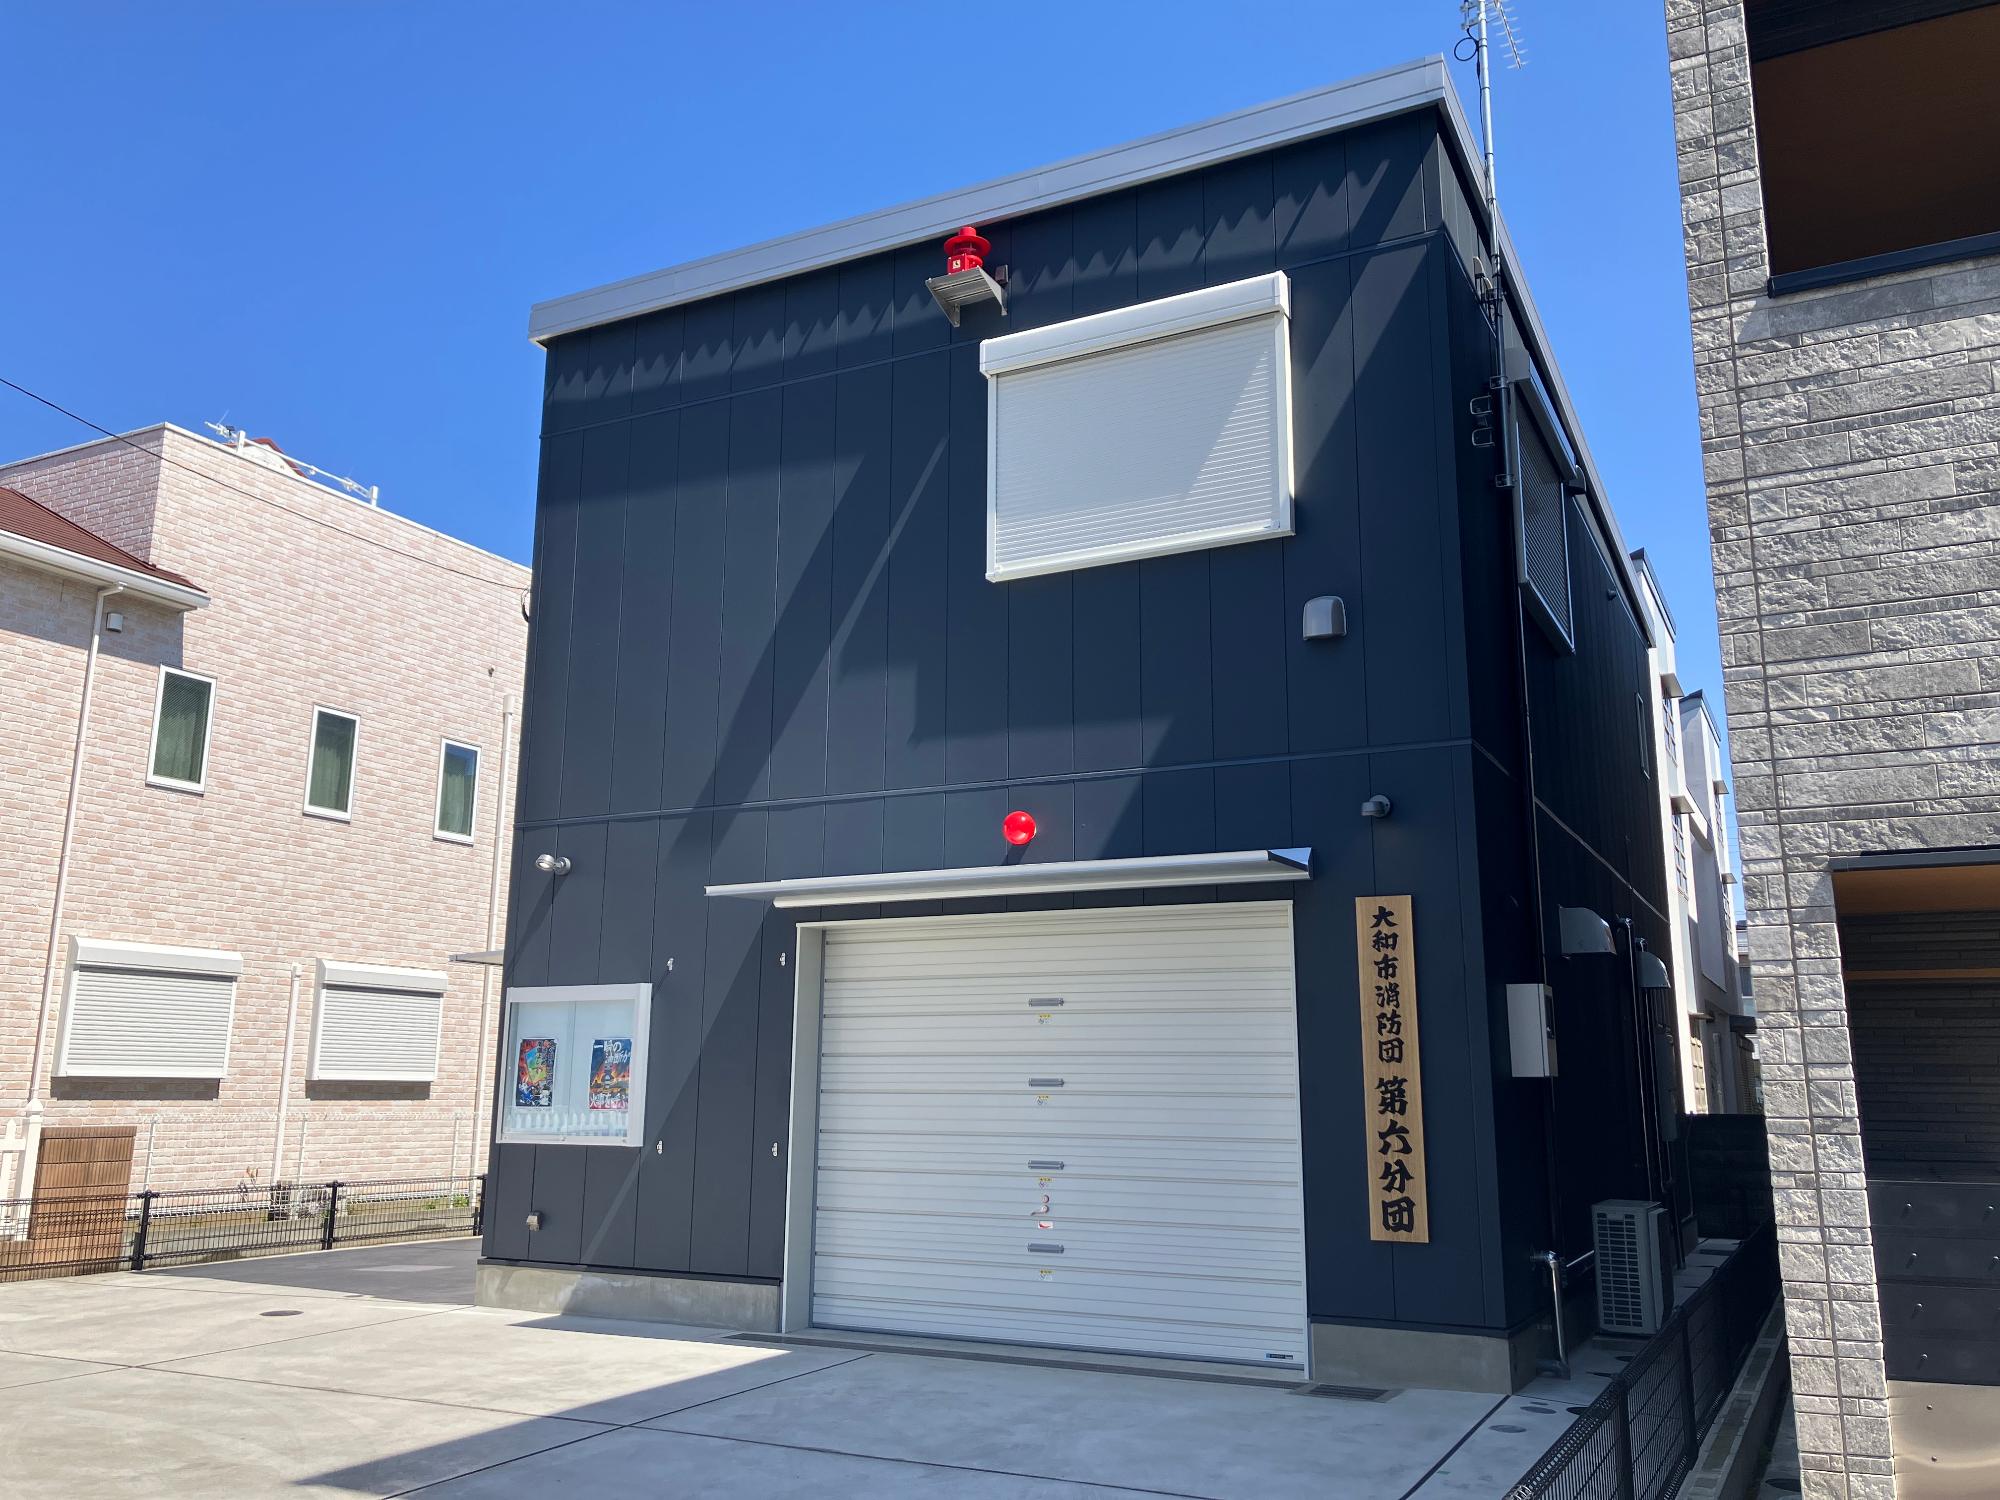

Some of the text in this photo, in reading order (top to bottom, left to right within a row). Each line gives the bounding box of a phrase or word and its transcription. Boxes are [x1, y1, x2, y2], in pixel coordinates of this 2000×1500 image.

[1370, 905, 1416, 1234] 大和市消防団 第六分団
